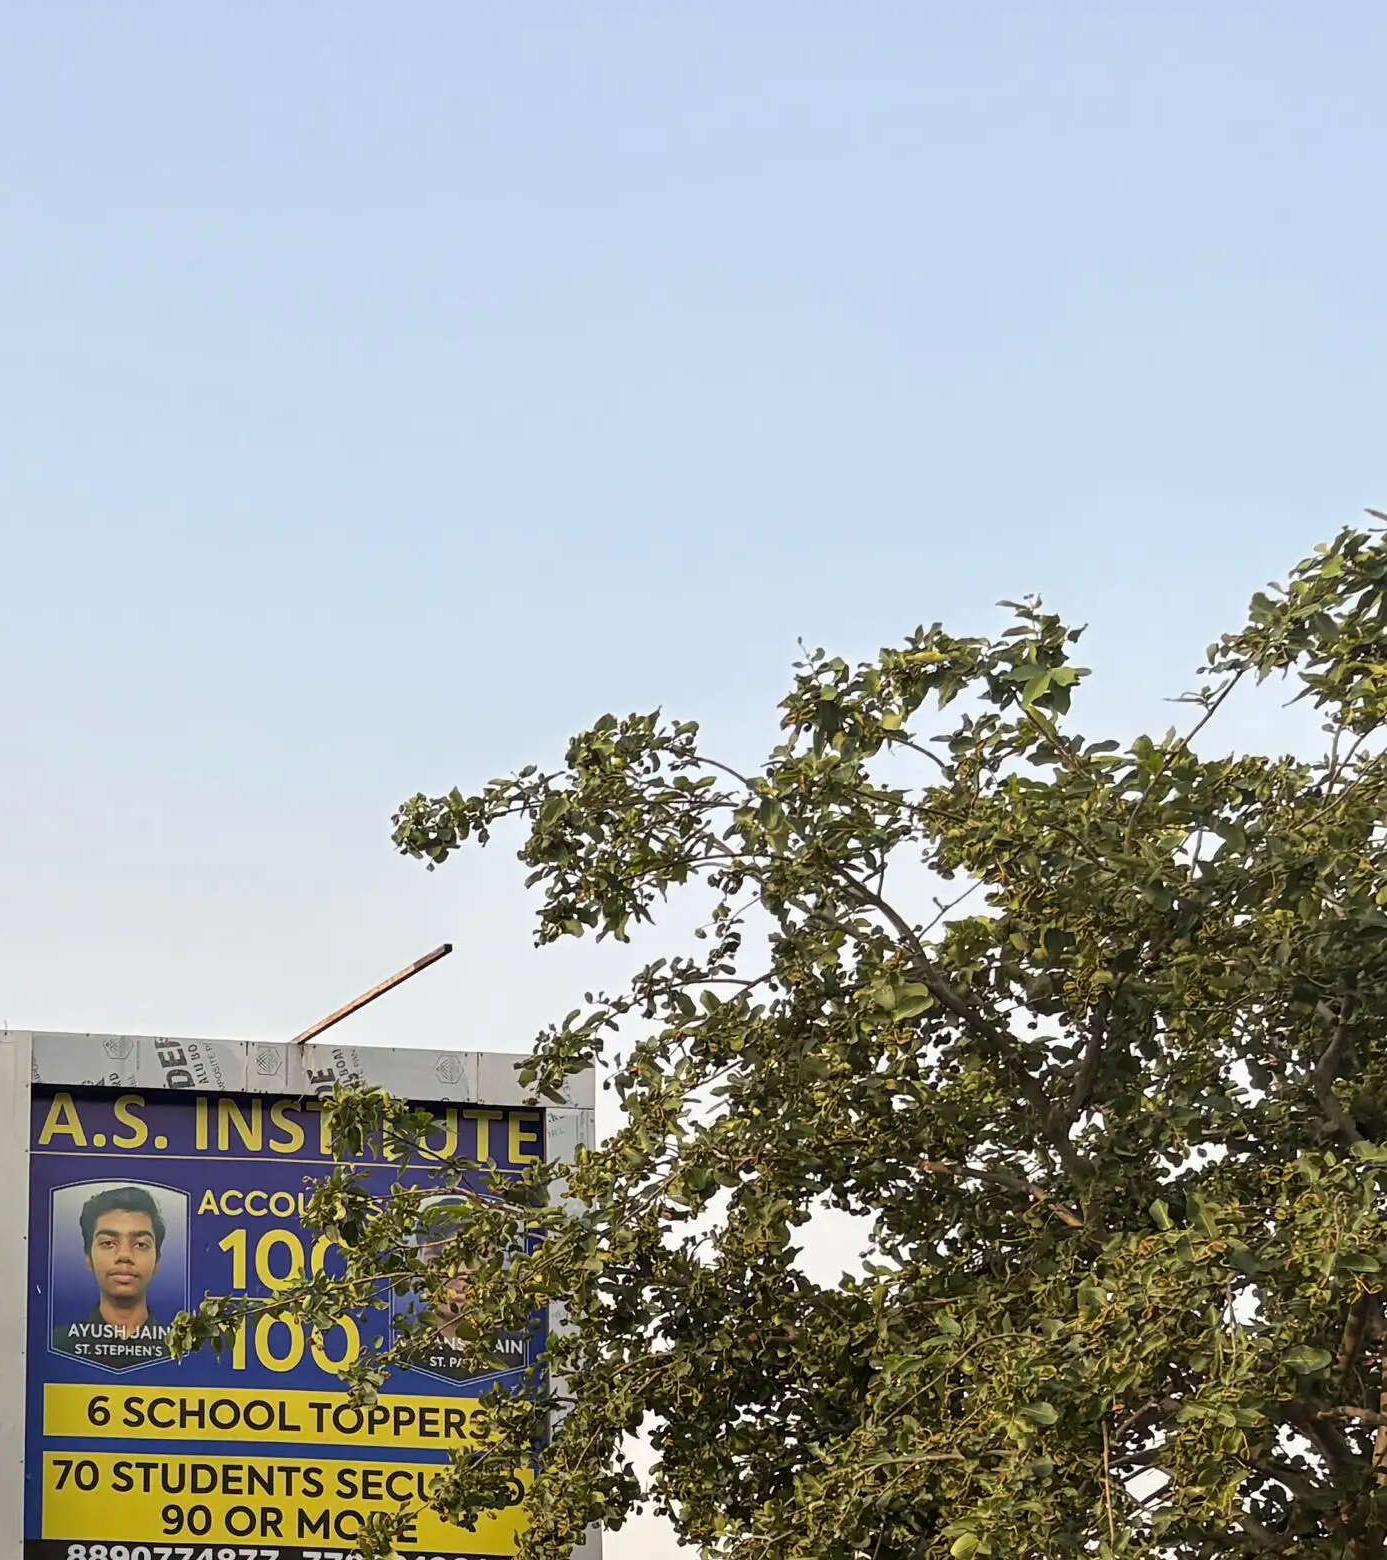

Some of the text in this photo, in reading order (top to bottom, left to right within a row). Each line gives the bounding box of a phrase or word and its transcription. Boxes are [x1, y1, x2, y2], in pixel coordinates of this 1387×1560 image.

[38, 1093, 540, 1165] A.S. INSTUTE
[68, 1322, 170, 1342] AYUSH JAIN
[74, 1343, 163, 1358] ST. STEPHEN'S
[87, 1396, 492, 1440] 6 SCHOOL TOPPERS
[52, 1459, 324, 1498] 70 STUDENTS
[162, 1504, 213, 1536] 90
[225, 1507, 285, 1538] OR
